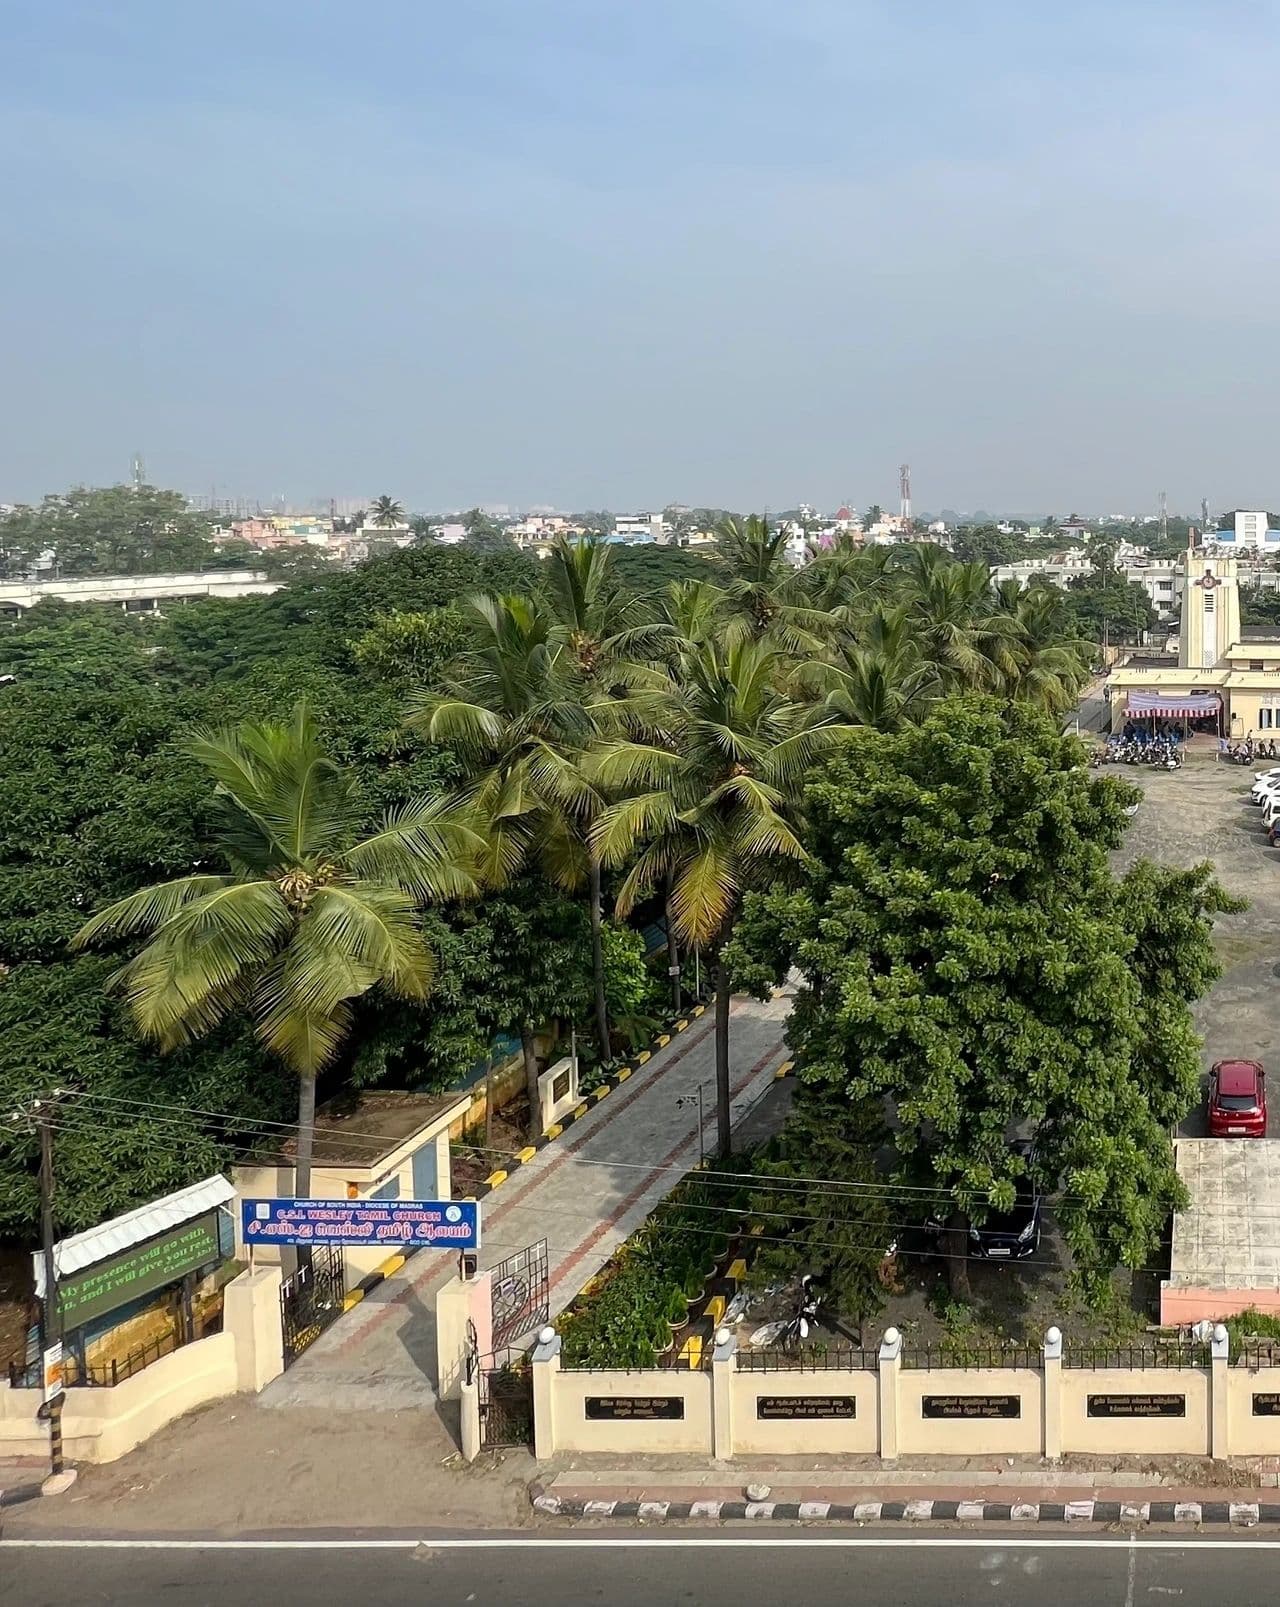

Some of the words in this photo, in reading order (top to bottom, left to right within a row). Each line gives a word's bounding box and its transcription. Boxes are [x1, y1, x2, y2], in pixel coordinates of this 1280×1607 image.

[276, 1209, 306, 1220] C.S.I.
[307, 1209, 354, 1220] WESLEY
[356, 1210, 391, 1221] TAMIL
[392, 1211, 442, 1222] CHURCH
[376, 1221, 414, 1240] தமிழ்
[415, 1222, 472, 1240] ஆலயம்
[59, 1284, 78, 1298] My
[82, 1258, 137, 1292] presence
[139, 1245, 161, 1262] will
[162, 1240, 178, 1254] go
[180, 1227, 205, 1244] with
[80, 1285, 103, 1303] and
[106, 1280, 112, 1291] I
[115, 1269, 136, 1287] will
[138, 1258, 163, 1277] give
[165, 1247, 188, 1266] you
